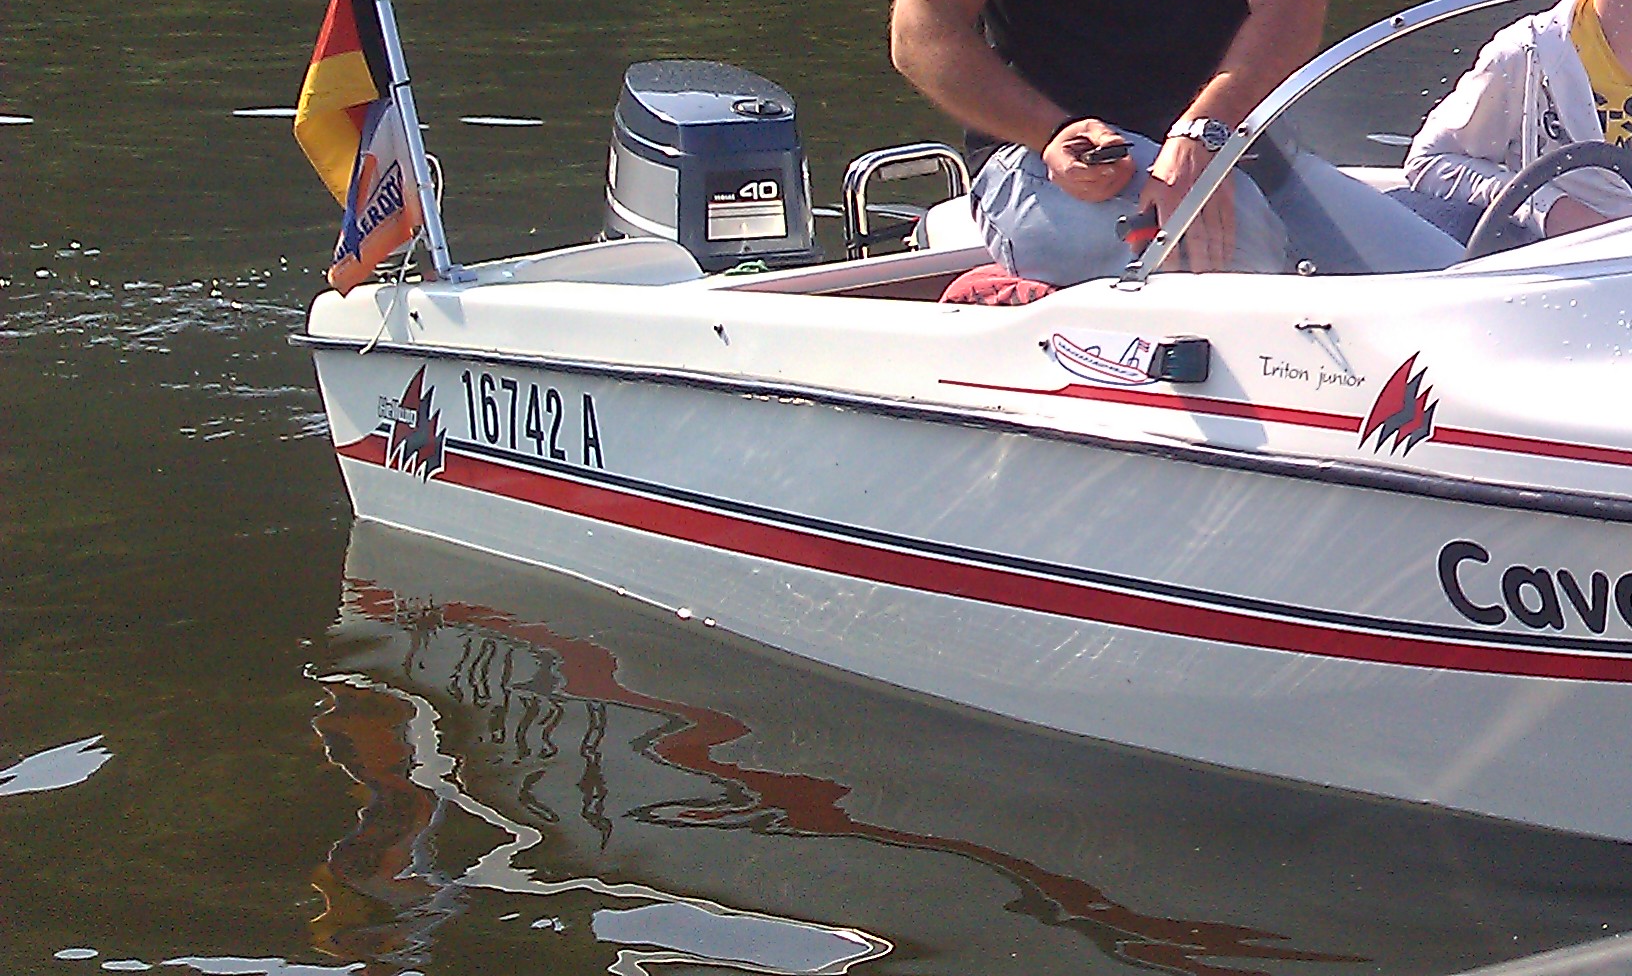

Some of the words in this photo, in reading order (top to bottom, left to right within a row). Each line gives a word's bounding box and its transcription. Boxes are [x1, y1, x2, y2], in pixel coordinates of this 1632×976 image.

[740, 181, 778, 200] 40
[1259, 355, 1309, 382] Triton
[1315, 365, 1366, 391] junior
[460, 368, 567, 461] 16742
[582, 392, 605, 470] A
